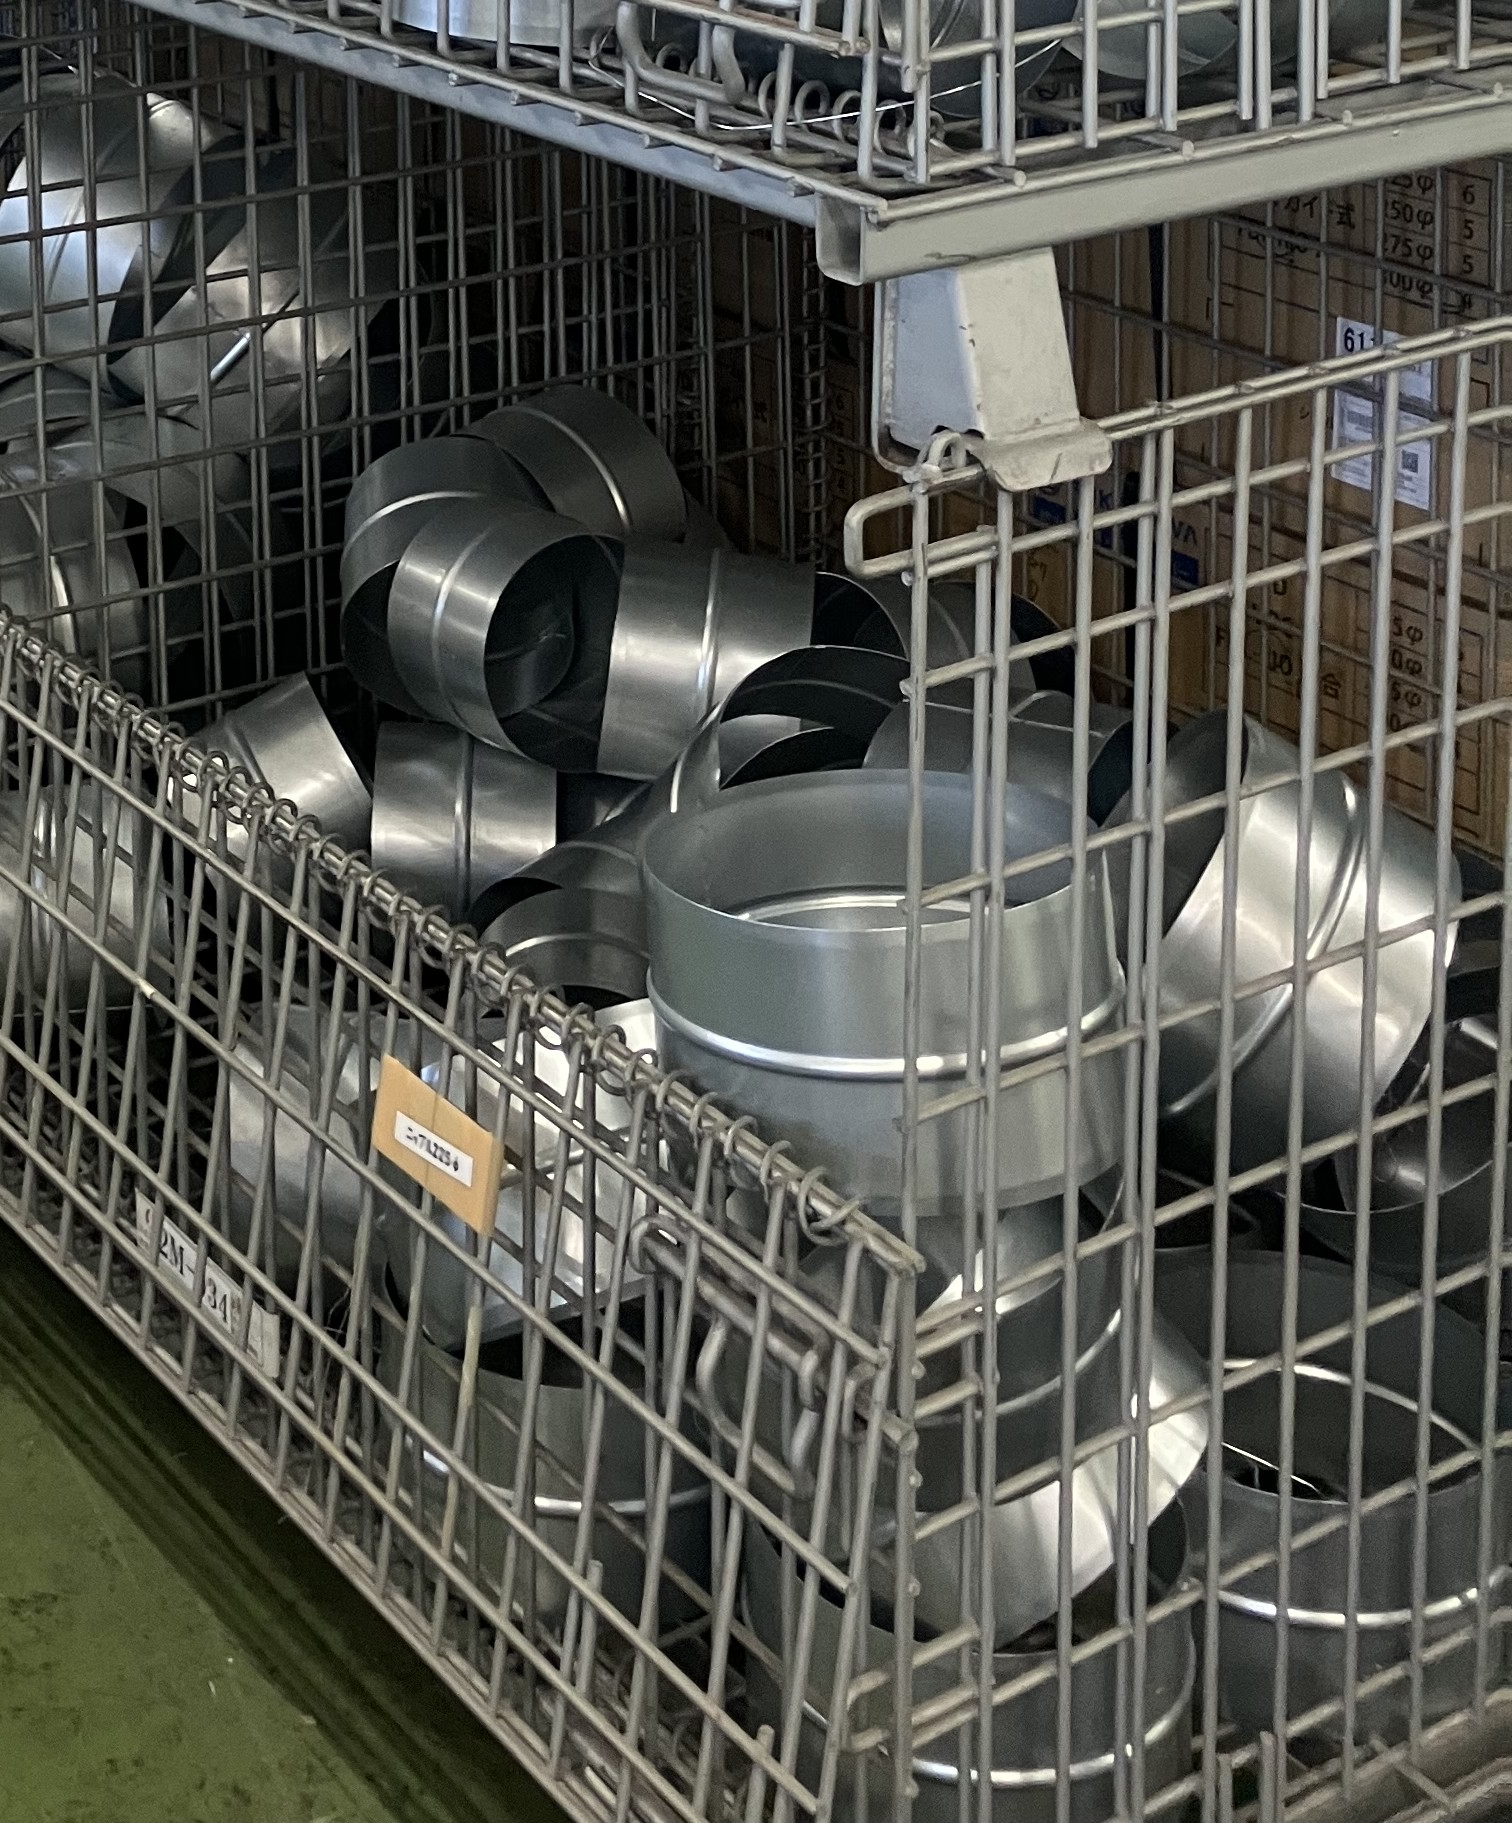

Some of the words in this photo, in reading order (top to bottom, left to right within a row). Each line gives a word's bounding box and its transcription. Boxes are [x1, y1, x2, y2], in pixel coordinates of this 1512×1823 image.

[1462, 184, 1475, 205] 6
[1462, 219, 1475, 241] 5
[1462, 254, 1474, 275] 5
